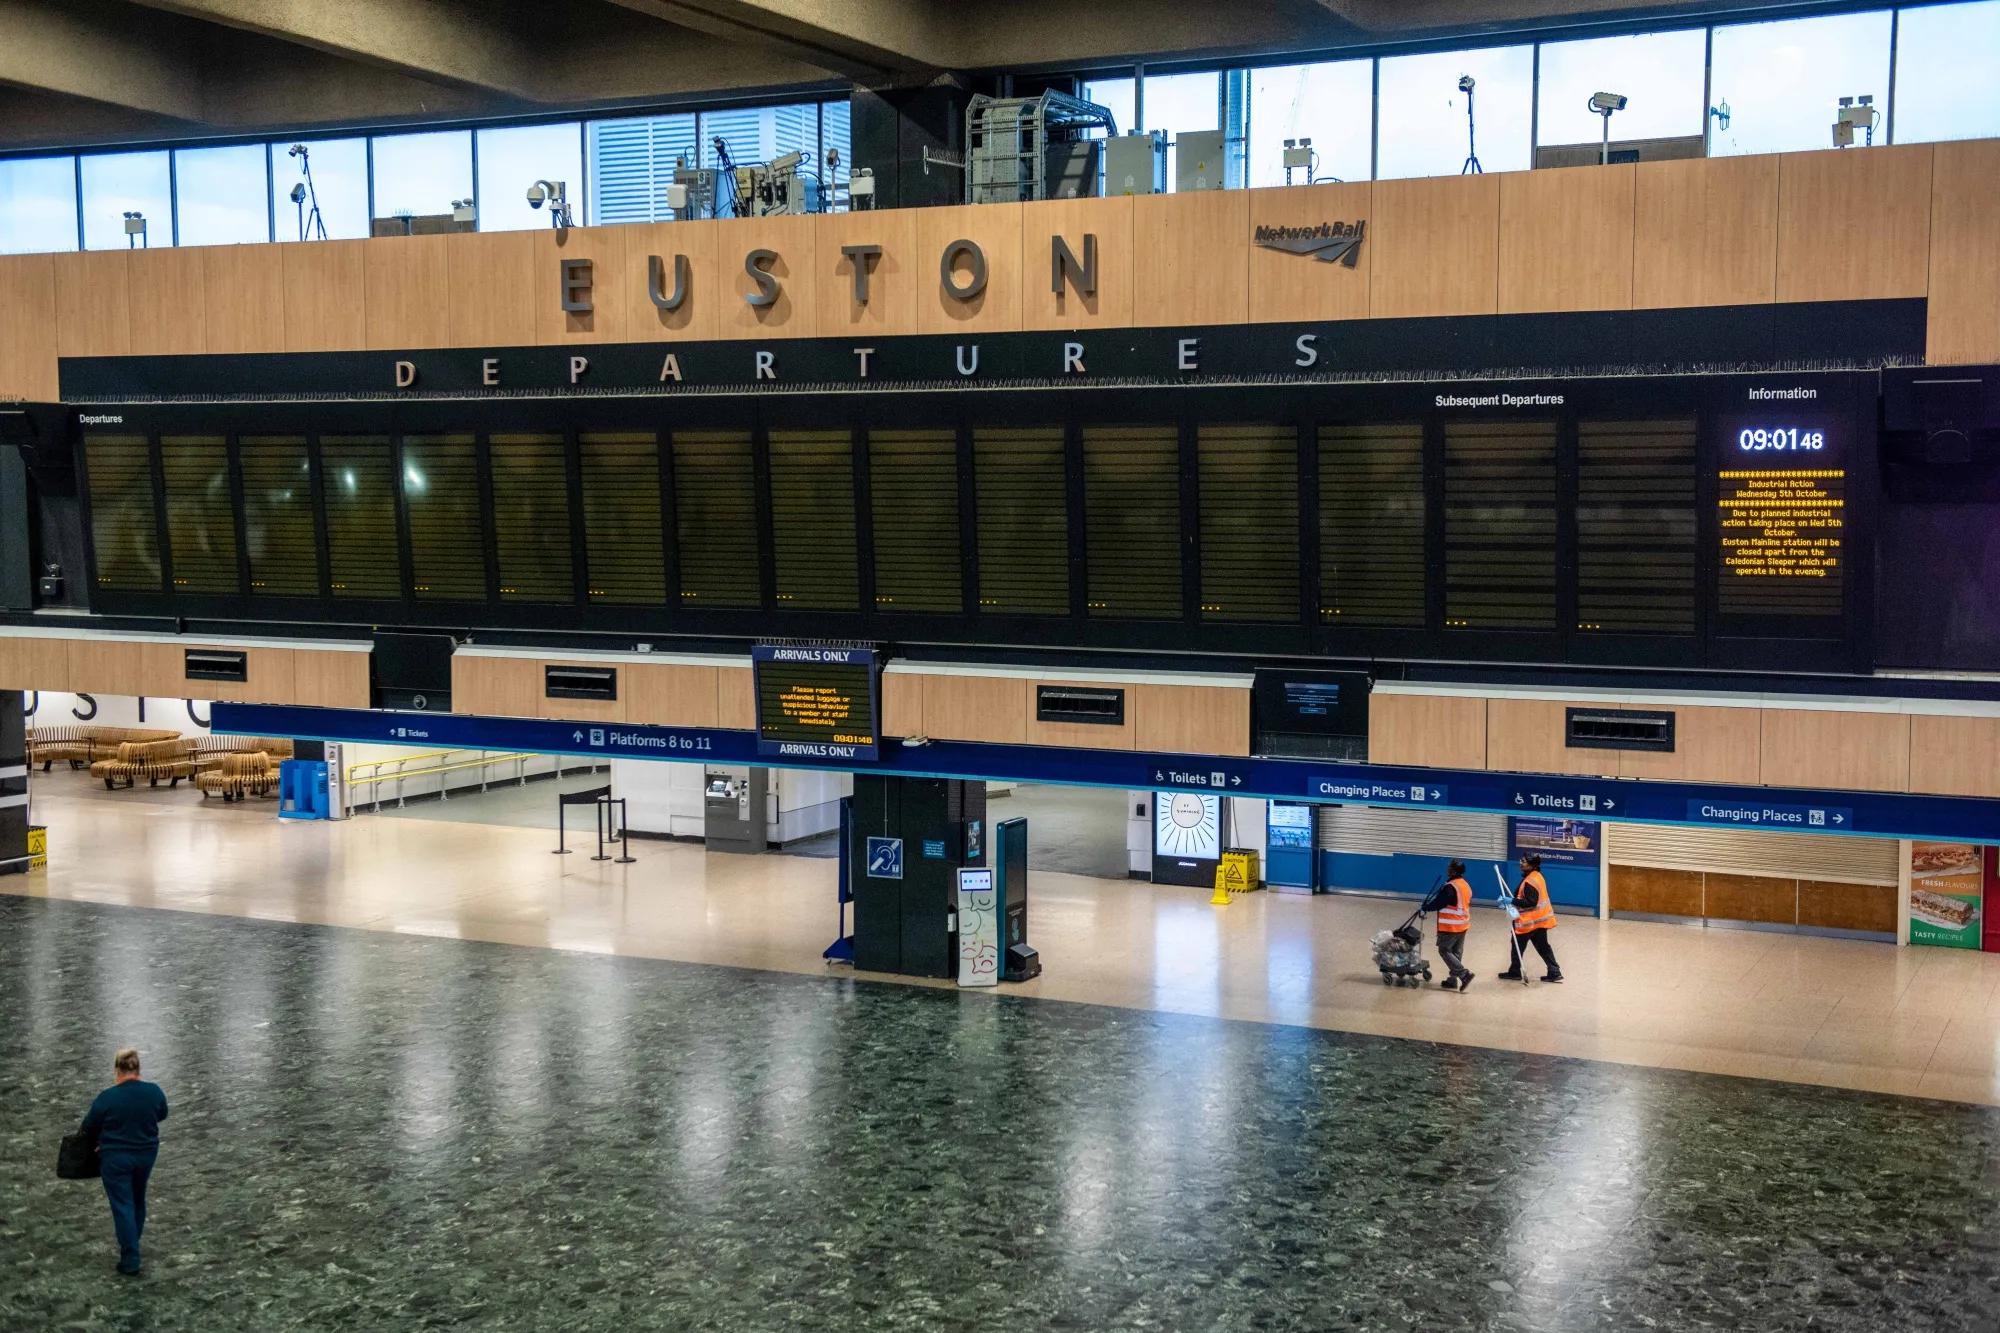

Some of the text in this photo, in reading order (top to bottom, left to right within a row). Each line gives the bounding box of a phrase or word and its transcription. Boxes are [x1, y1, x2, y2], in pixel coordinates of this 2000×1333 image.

[561, 233, 1096, 312] EUSTON
[395, 334, 1318, 387] DEPARTURES
[1749, 387, 1817, 399] Information
[1435, 394, 1564, 408] Subsequent Departures
[79, 414, 123, 425] Departures
[1736, 490, 1777, 498] Wednesday
[1761, 510, 1791, 518] planned
[1748, 520, 1772, 528] taking
[1722, 538, 1749, 546] Euston
[1751, 538, 1781, 546] Mainline
[1783, 538, 1812, 546] station
[1736, 548, 1762, 556] closed
[1764, 548, 1786, 557] apart
[1811, 548, 1825, 556] the
[1767, 558, 1797, 566] Sleeper
[1799, 558, 1820, 566] which
[1822, 558, 1837, 566] will
[1735, 568, 1767, 576] operate
[1794, 568, 1826, 577] evening.
[773, 650, 850, 661] ARRIVALS ONLY
[816, 695, 841, 703] luggage
[407, 729, 429, 738] Tickets
[610, 732, 712, 750] Platforms 8 to 11
[833, 734, 873, 744] 09:01:48
[780, 744, 855, 757] ARRIVALS ONLY
[1169, 771, 1207, 784] Toilets
[1320, 783, 1405, 798] Changing Places
[1531, 794, 1575, 808] Toilets
[1702, 806, 1802, 822] Changing Places
[1944, 881, 1979, 890] FLAVOURS
[1914, 931, 1937, 939] TASTY
